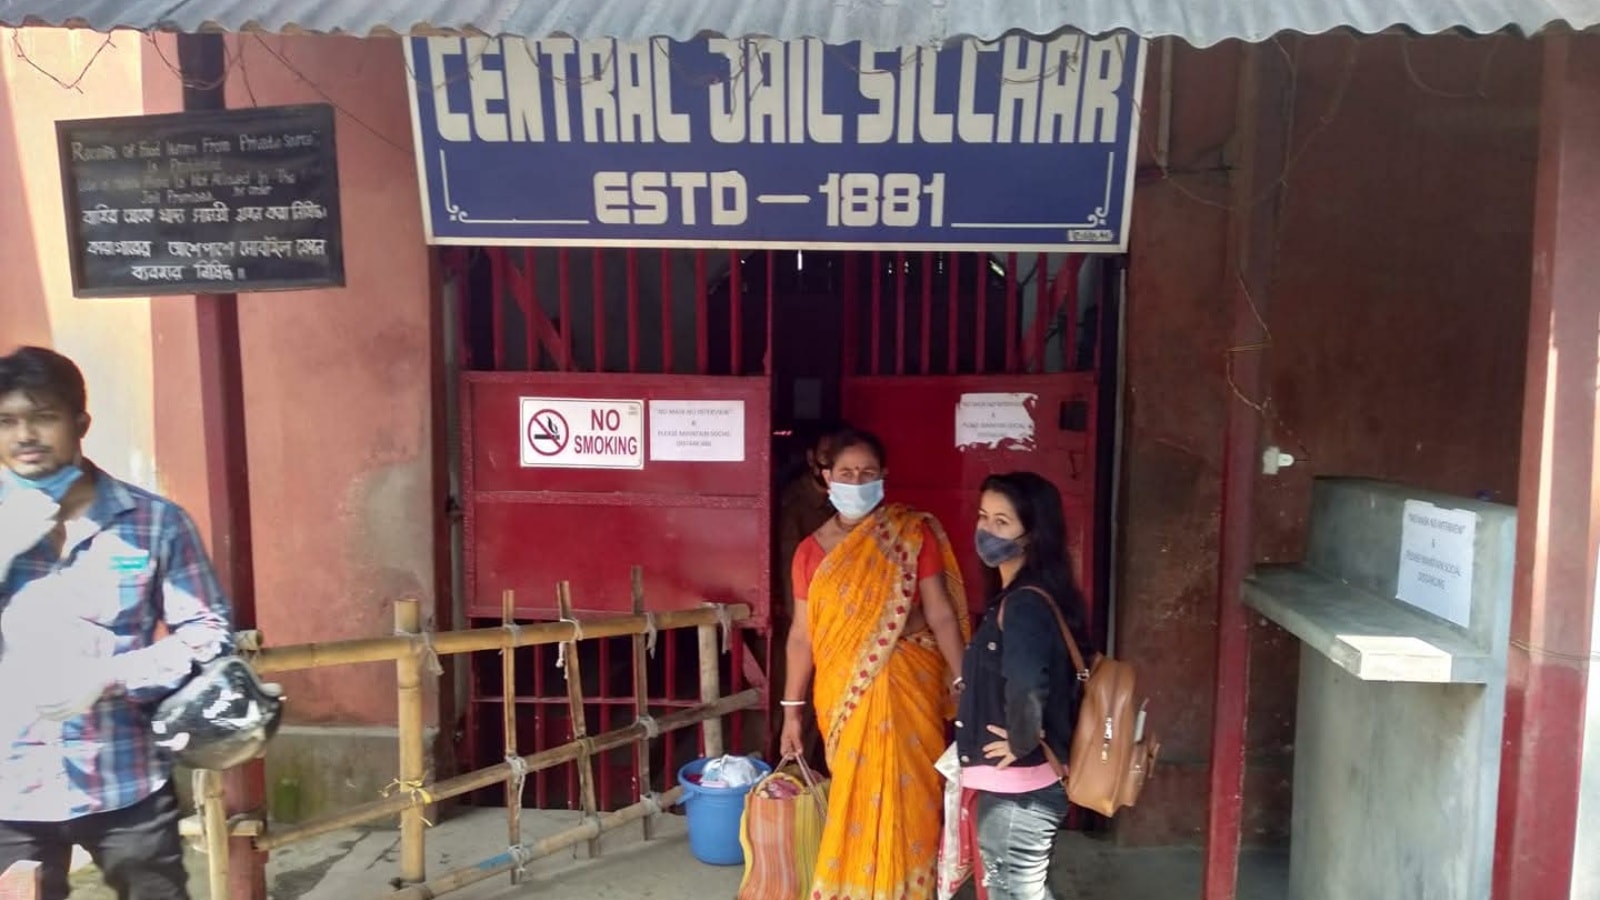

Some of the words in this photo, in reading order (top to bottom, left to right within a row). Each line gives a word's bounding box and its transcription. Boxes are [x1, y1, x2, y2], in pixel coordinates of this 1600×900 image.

[427, 36, 691, 143] CENTRAL
[708, 37, 843, 143] JAIL
[857, 34, 1125, 143] SILCHAR
[593, 170, 748, 226] ESTD
[819, 172, 945, 227] 1881
[591, 409, 621, 431] NO
[574, 435, 638, 456] SMOKING
